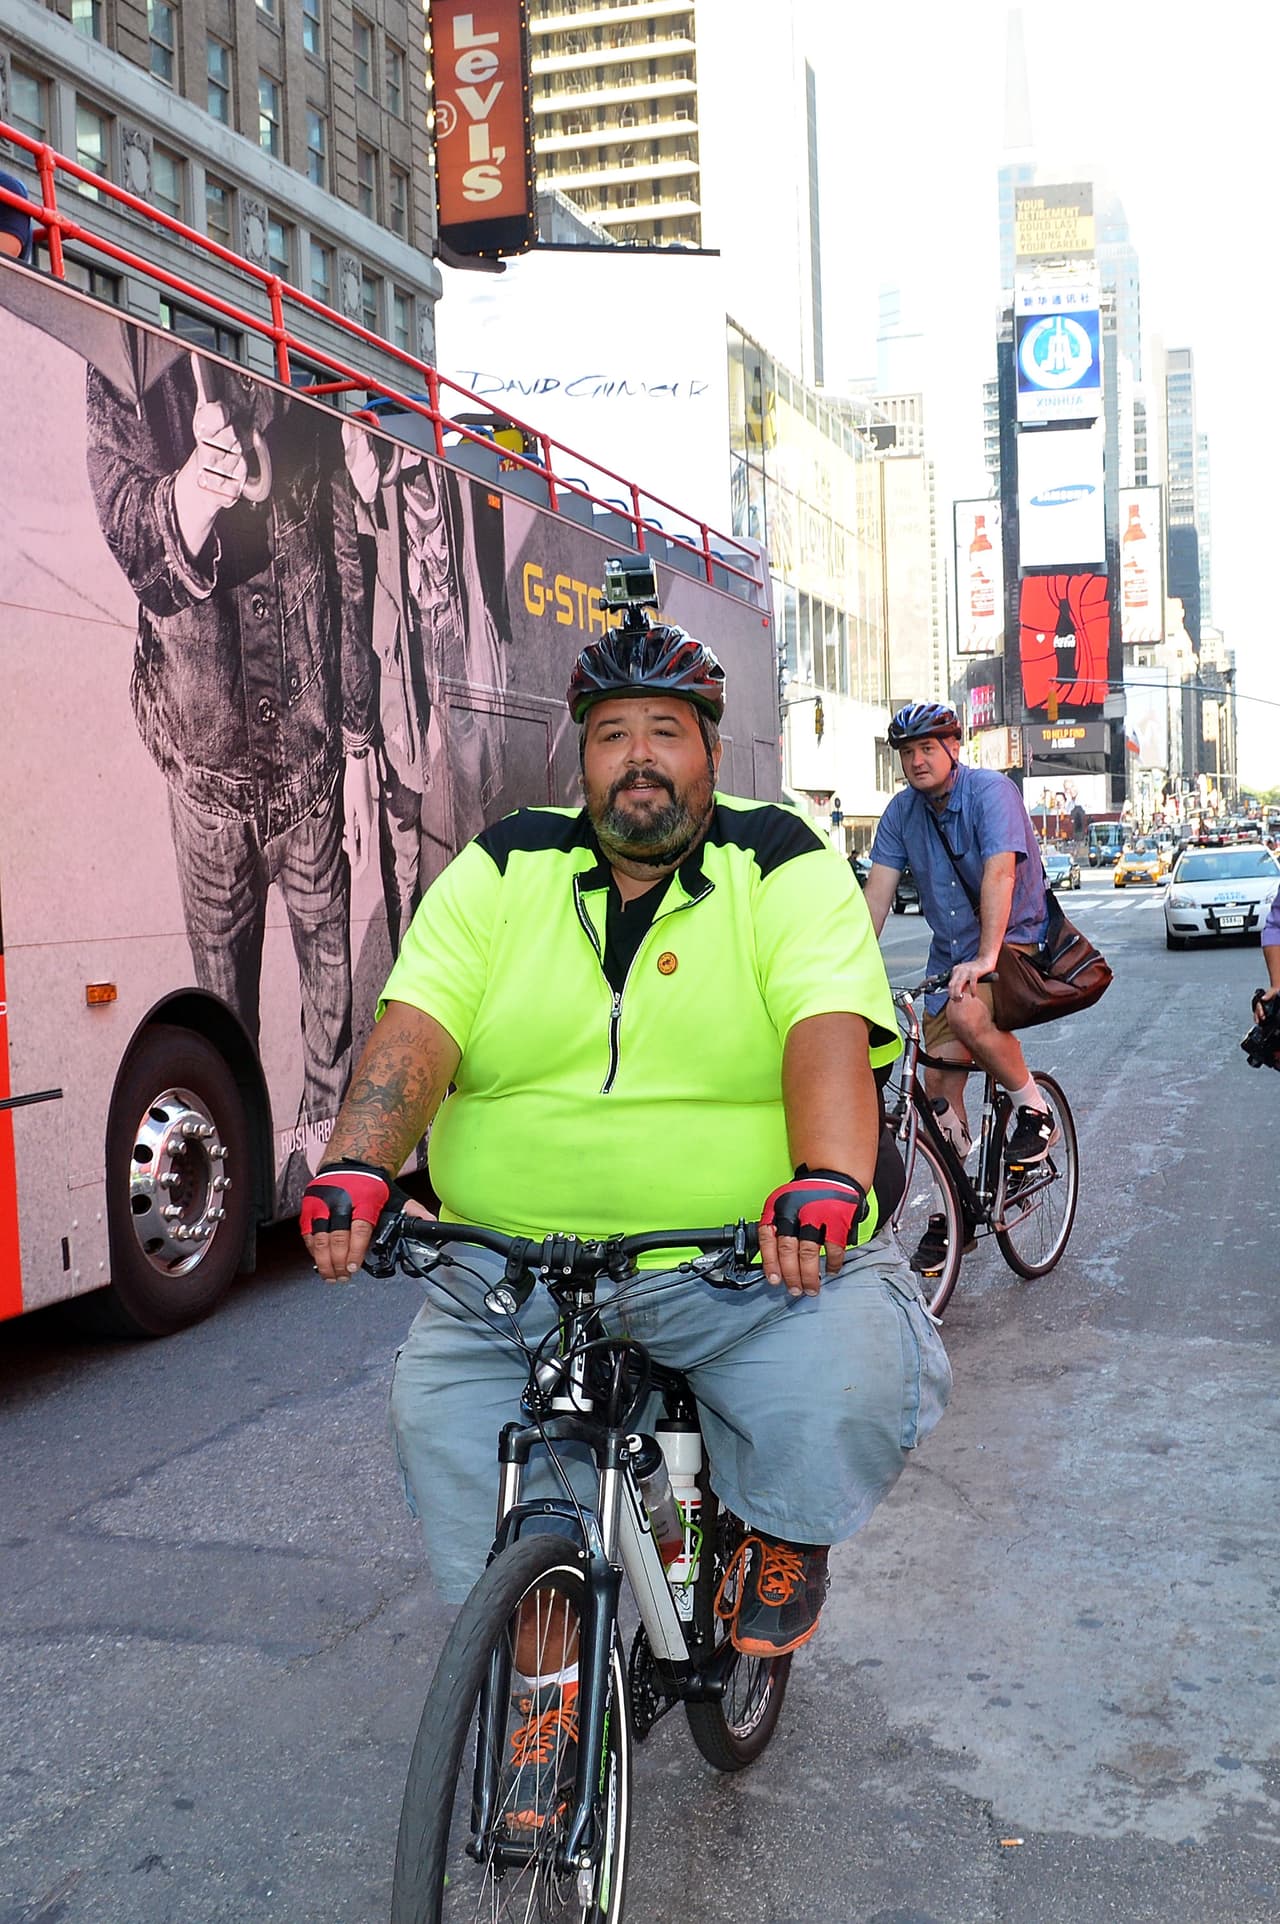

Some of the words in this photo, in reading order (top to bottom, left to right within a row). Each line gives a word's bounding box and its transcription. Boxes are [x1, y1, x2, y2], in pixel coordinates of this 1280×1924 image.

[1017, 199, 1045, 210] YOUR
[1019, 219, 1051, 232] COULD
[1054, 218, 1079, 229] LAST
[1020, 231, 1033, 241] AS
[1036, 229, 1061, 240] LONG
[1065, 229, 1078, 239] AS
[1020, 241, 1046, 252] YOUR
[1049, 239, 1088, 249] CAREER
[456, 370, 561, 396] DAVID
[1042, 729, 1051, 740] TO
[1051, 728, 1069, 740] HELP
